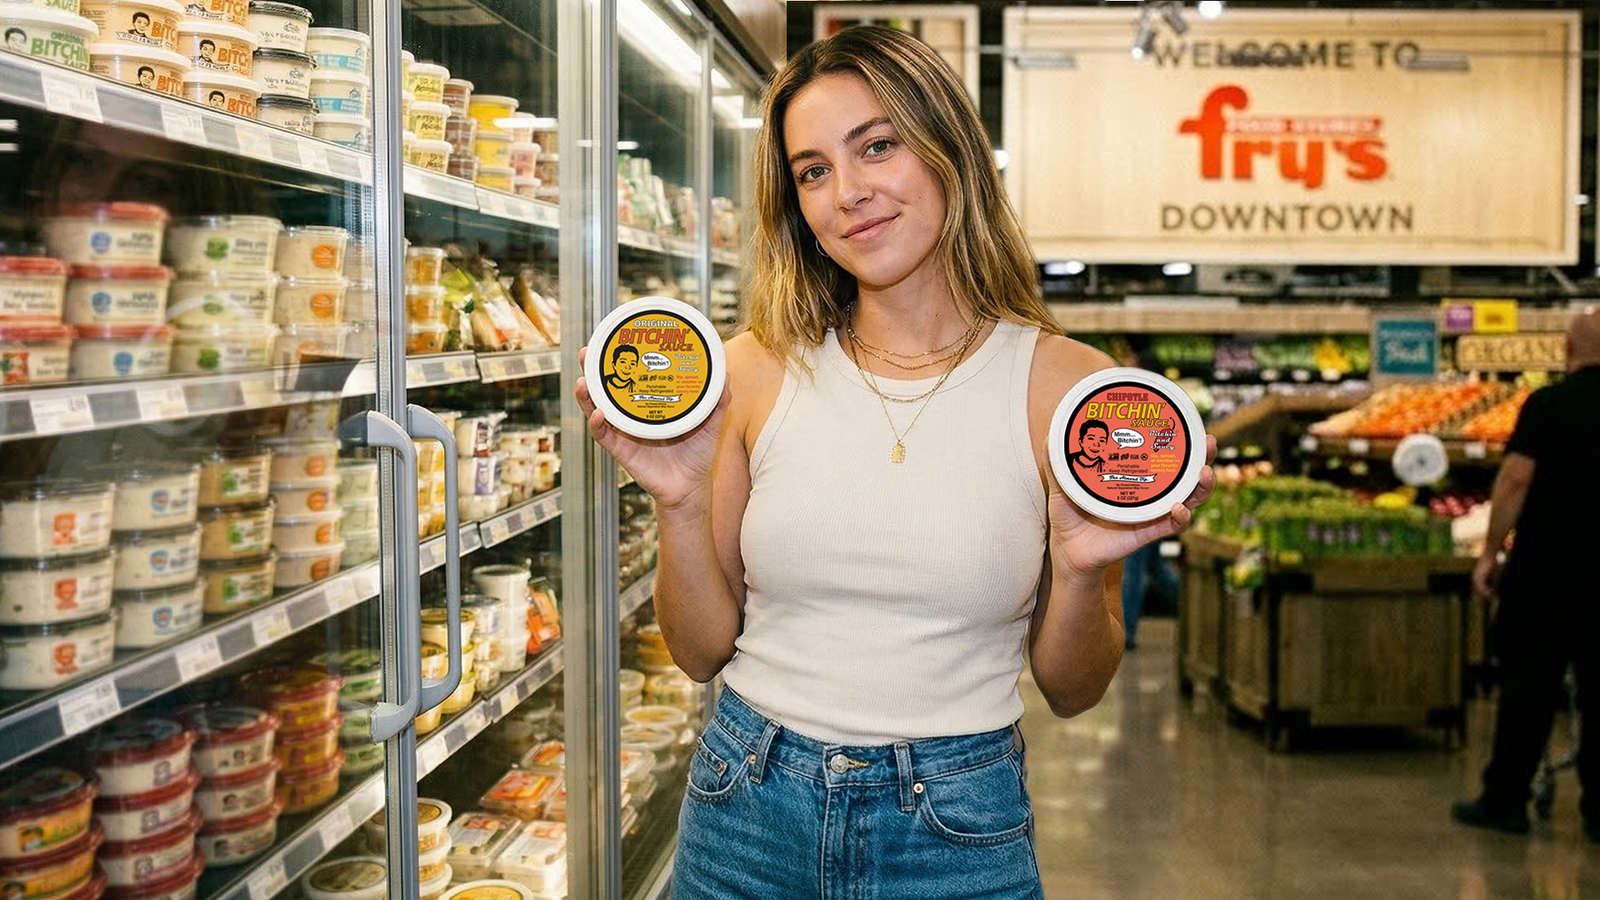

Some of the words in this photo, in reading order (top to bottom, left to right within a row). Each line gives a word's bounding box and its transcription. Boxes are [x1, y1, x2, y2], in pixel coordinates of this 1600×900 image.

[1153, 42, 1354, 69] WELCOME
[1370, 42, 1422, 69] TO
[1179, 85, 1388, 190] fry's
[1161, 204, 1414, 232] DOWNTOWN
[634, 319, 679, 328] ORIGINAL
[618, 328, 691, 344] BITCHIN'
[658, 344, 694, 352] SAUCE
[1106, 392, 1149, 402] CHIPOTLE
[1086, 402, 1166, 420] BITCHIN'
[1130, 419, 1169, 428] SAUCE
